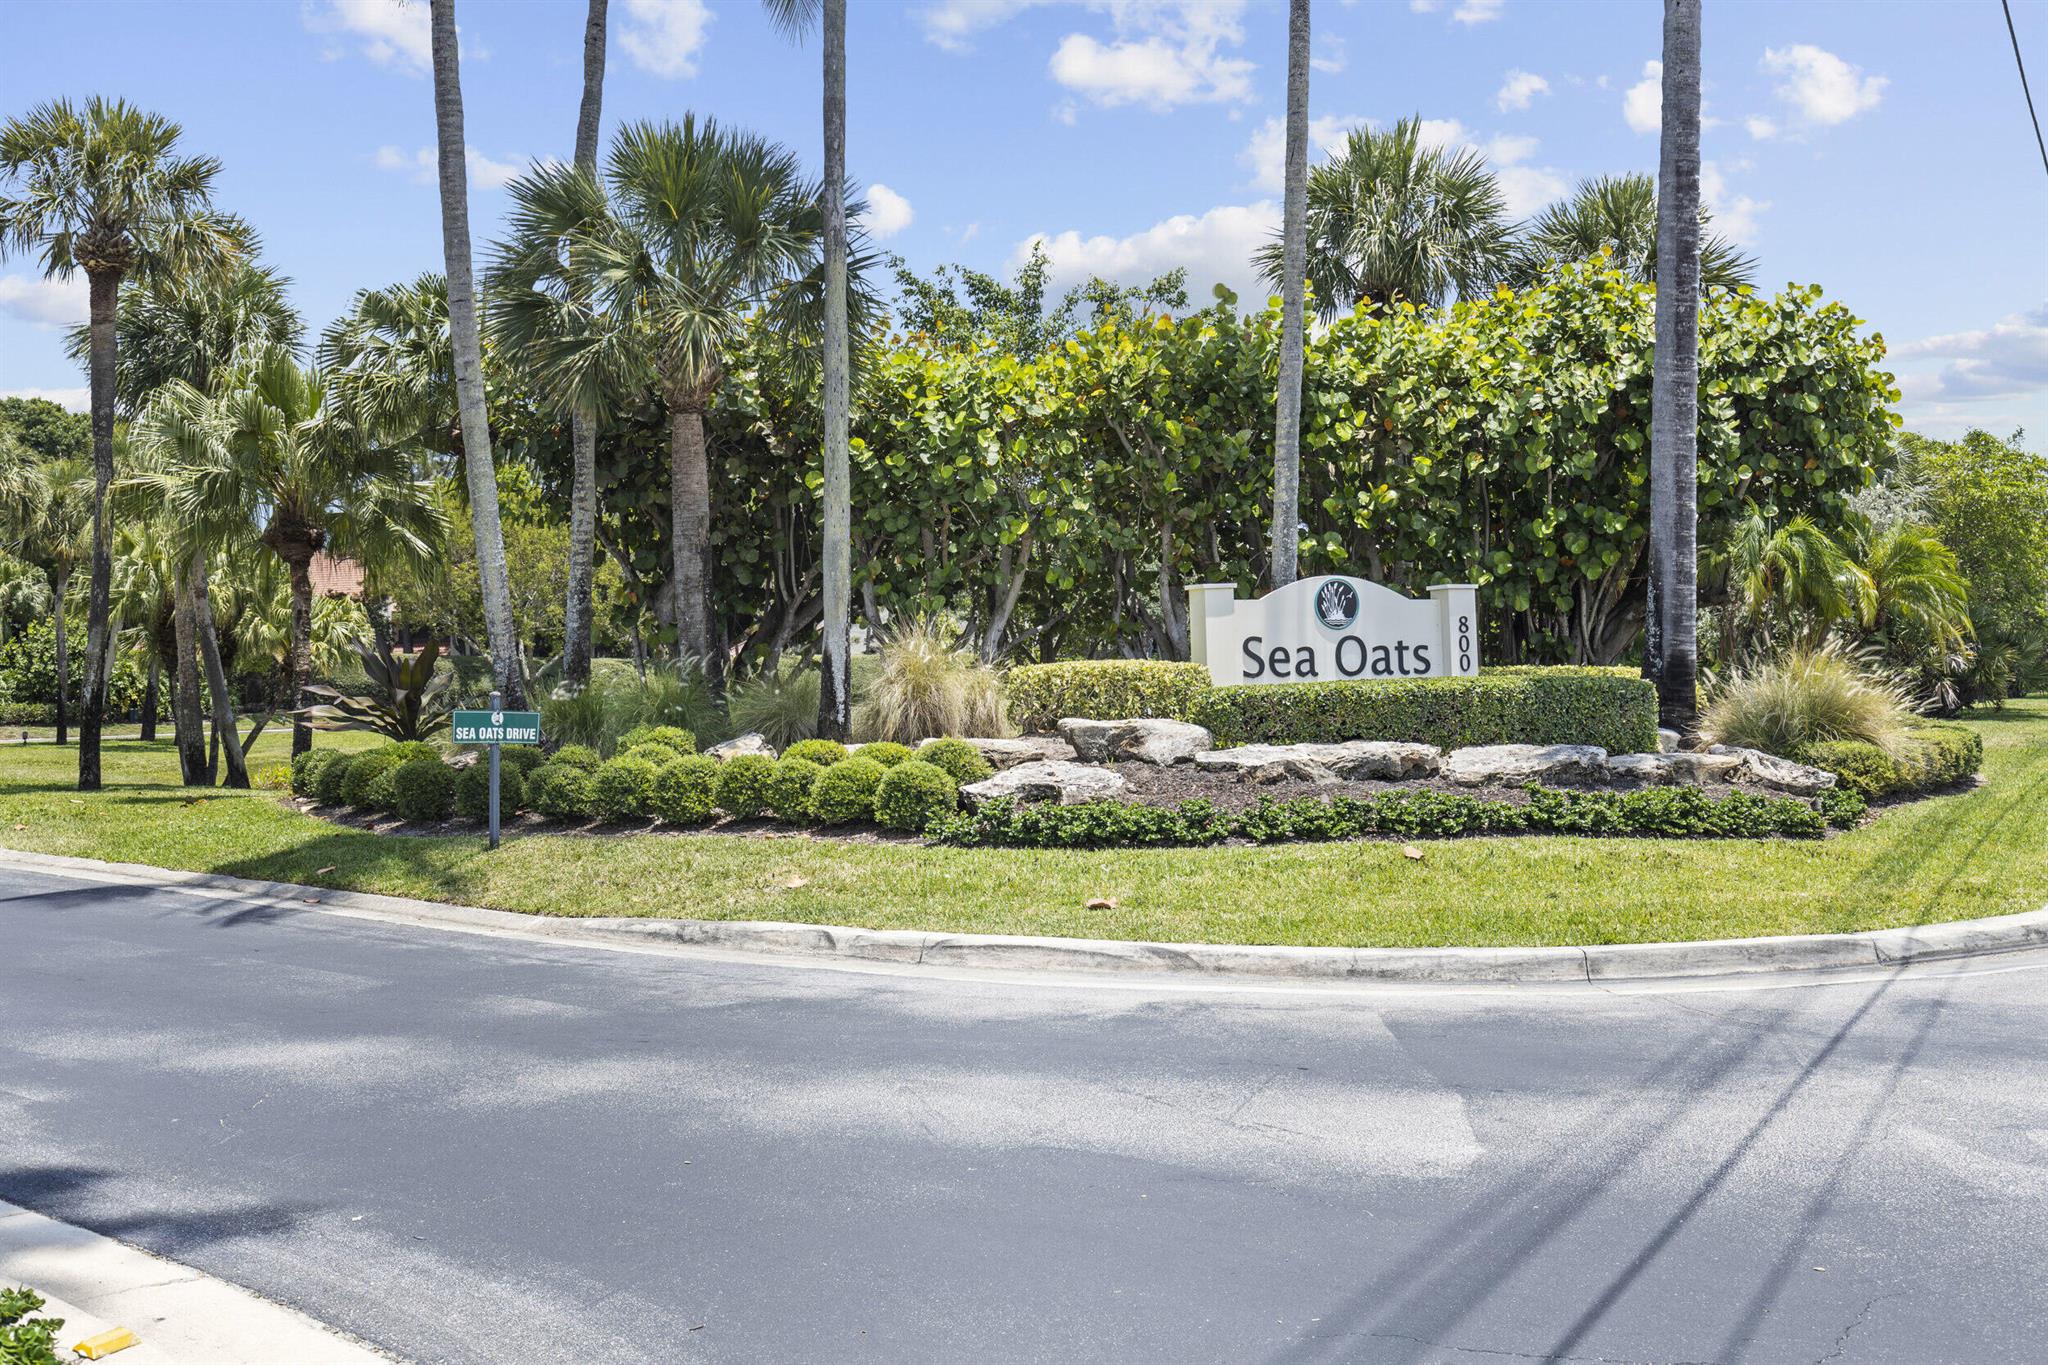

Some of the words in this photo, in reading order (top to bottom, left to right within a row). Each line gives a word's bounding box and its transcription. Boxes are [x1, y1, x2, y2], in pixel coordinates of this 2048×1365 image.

[1242, 636, 1319, 679] Sea
[1335, 635, 1431, 677] Oats
[1458, 615, 1471, 672] 800
[456, 727, 476, 740] SEA
[479, 727, 504, 740] OATS
[506, 727, 536, 740] DRIVE
